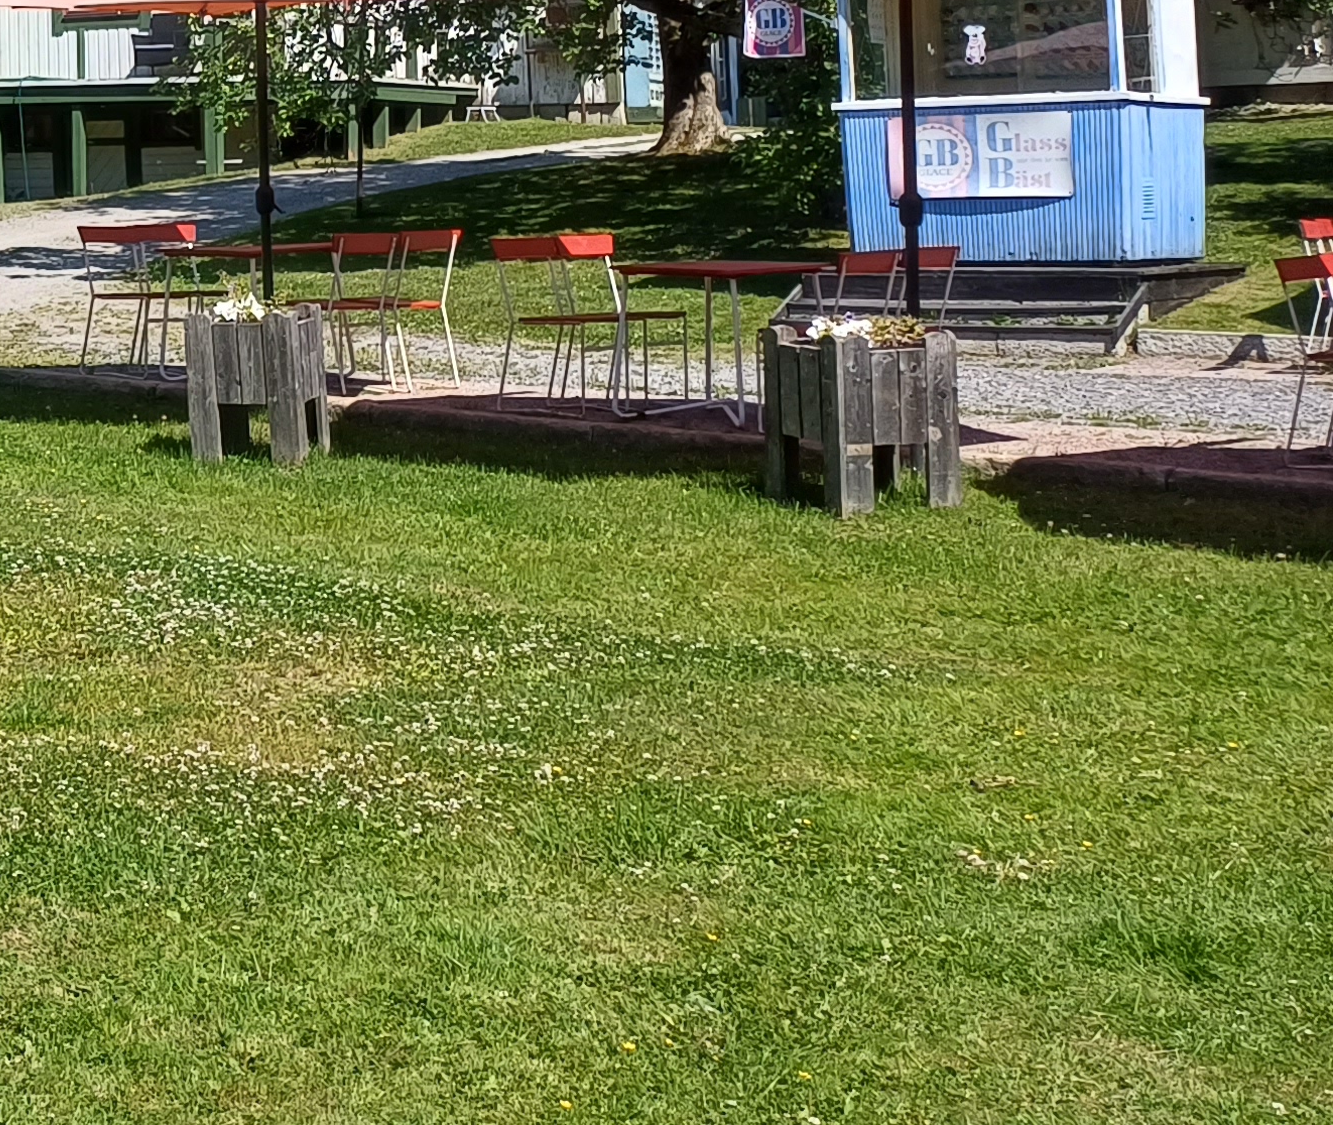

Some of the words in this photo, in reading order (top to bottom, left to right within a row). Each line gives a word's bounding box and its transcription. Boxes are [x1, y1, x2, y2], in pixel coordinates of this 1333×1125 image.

[755, 8, 787, 29] GB
[917, 138, 960, 167] GB
[986, 121, 1068, 154] Glass
[984, 157, 1052, 189] Bäst
